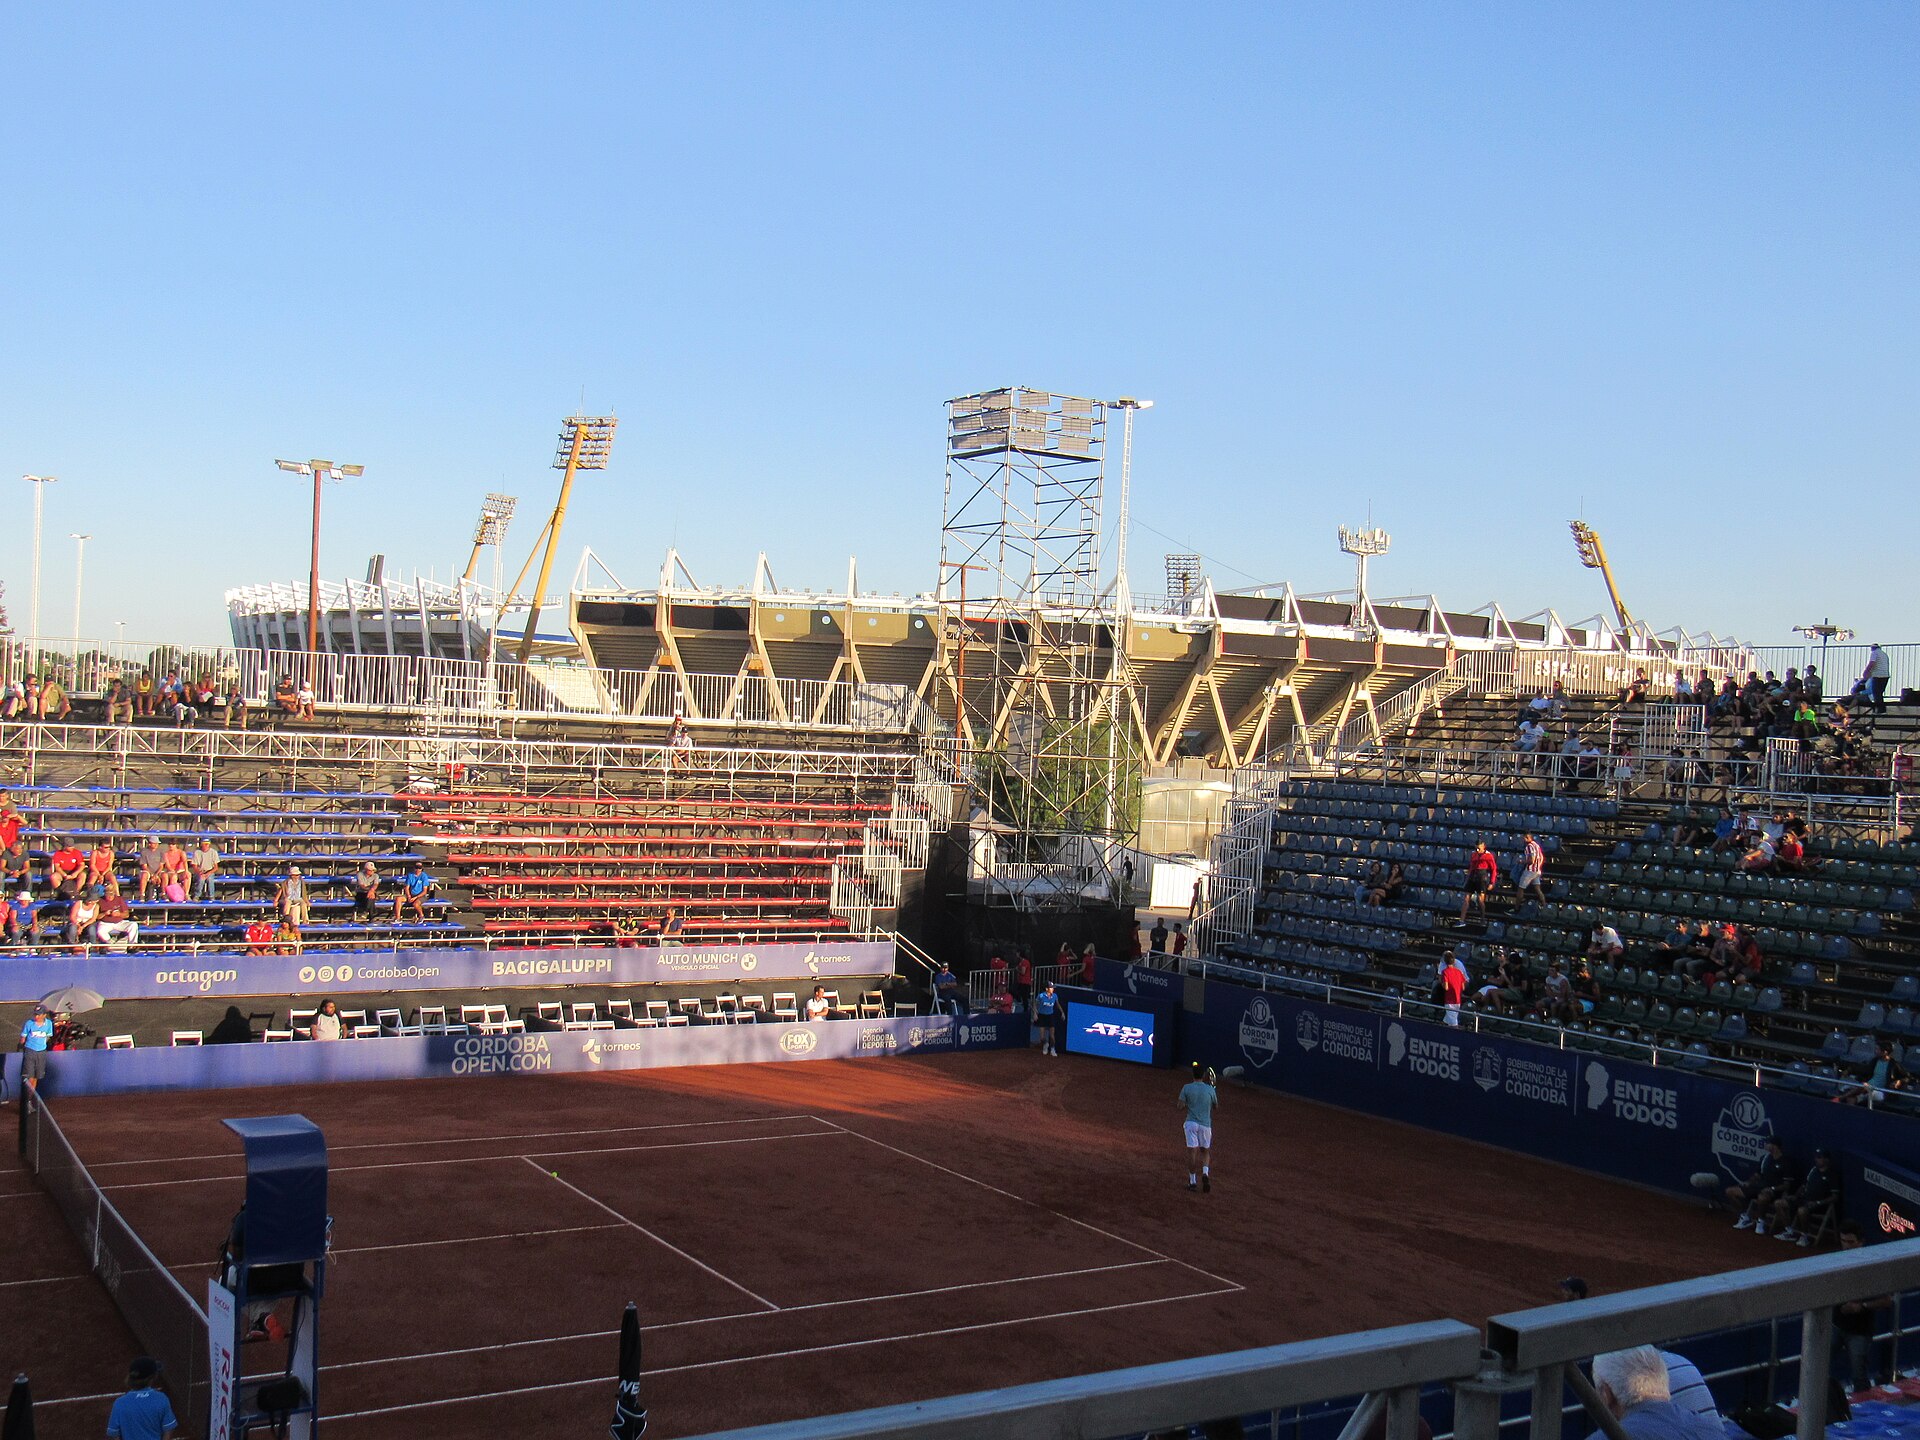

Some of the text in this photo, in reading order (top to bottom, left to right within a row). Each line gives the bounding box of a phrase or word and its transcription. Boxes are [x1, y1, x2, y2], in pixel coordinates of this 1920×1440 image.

[656, 953, 739, 965] AUTO MUNICH
[820, 955, 851, 963] torneos
[357, 965, 440, 980] CordobaOpen
[492, 959, 612, 976] BACIGALUPPI
[155, 969, 237, 991] octagon
[1138, 972, 1168, 988] torneos
[862, 1027, 884, 1036] Agencia
[971, 1025, 997, 1034] ENTRE
[1083, 1022, 1144, 1038] ATP
[1323, 1020, 1373, 1038] GOBIERNO DE LA
[454, 1035, 549, 1056] CORDOBA
[787, 1033, 809, 1045] FOX
[862, 1040, 897, 1049] DEPORTES
[971, 1033, 997, 1043] TODOS
[1118, 1037, 1143, 1046] 250
[1251, 1037, 1266, 1045] OPEN
[1323, 1029, 1373, 1049] PROVINCIA DE
[602, 1042, 641, 1052] torneos
[1409, 1037, 1460, 1063] ENTRE
[451, 1053, 551, 1074] OPEN.COM
[1408, 1054, 1460, 1082] TODOS
[1506, 1057, 1568, 1079] GOBIERNO DE LA
[1506, 1067, 1568, 1090] PROVINCIA DE
[1613, 1079, 1678, 1109] ENTRE
[1612, 1099, 1678, 1130] TODOS
[1716, 1128, 1765, 1149] CÓRDOB
[1731, 1144, 1757, 1157] OPEN
